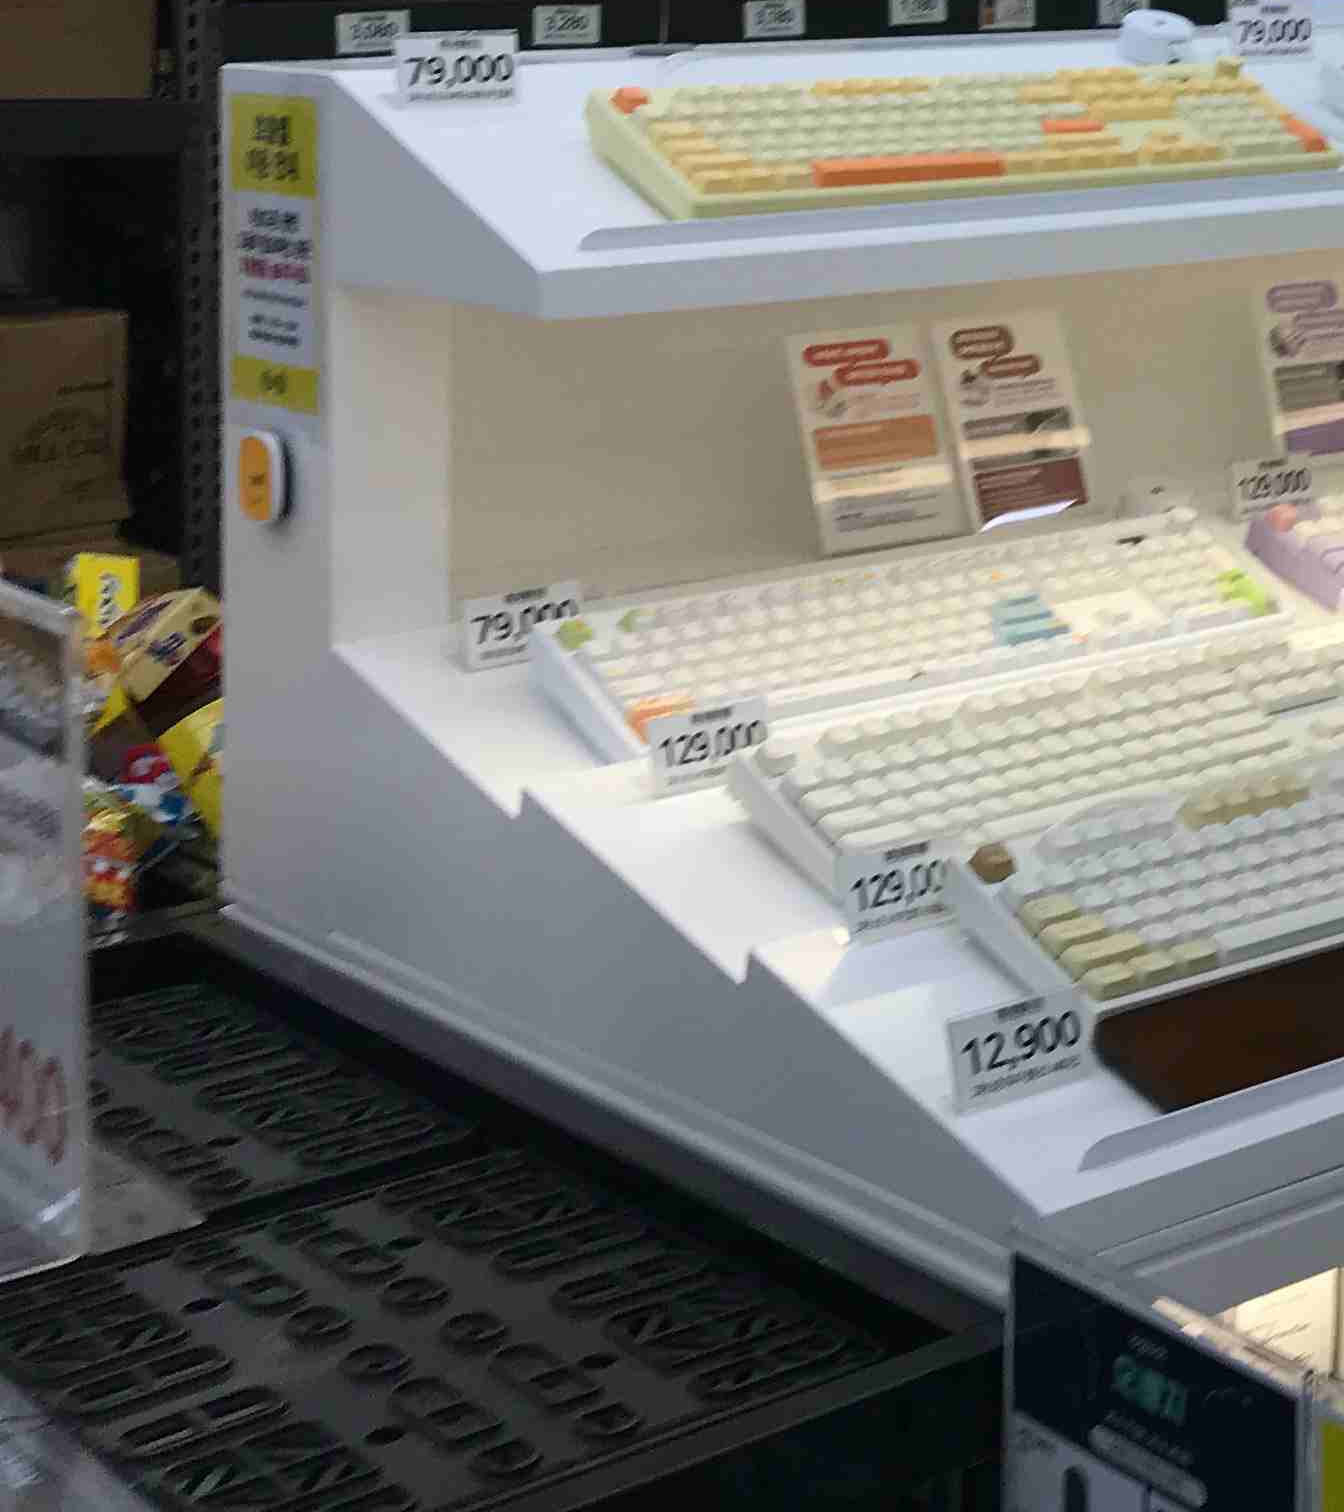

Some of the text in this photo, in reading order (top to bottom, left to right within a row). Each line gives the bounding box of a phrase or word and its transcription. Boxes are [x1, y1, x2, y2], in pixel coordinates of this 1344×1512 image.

[1238, 15, 1313, 46] 79,000
[403, 53, 515, 89] 79,000
[848, 858, 950, 913] 129,00
[960, 1009, 1084, 1078] 12,900
